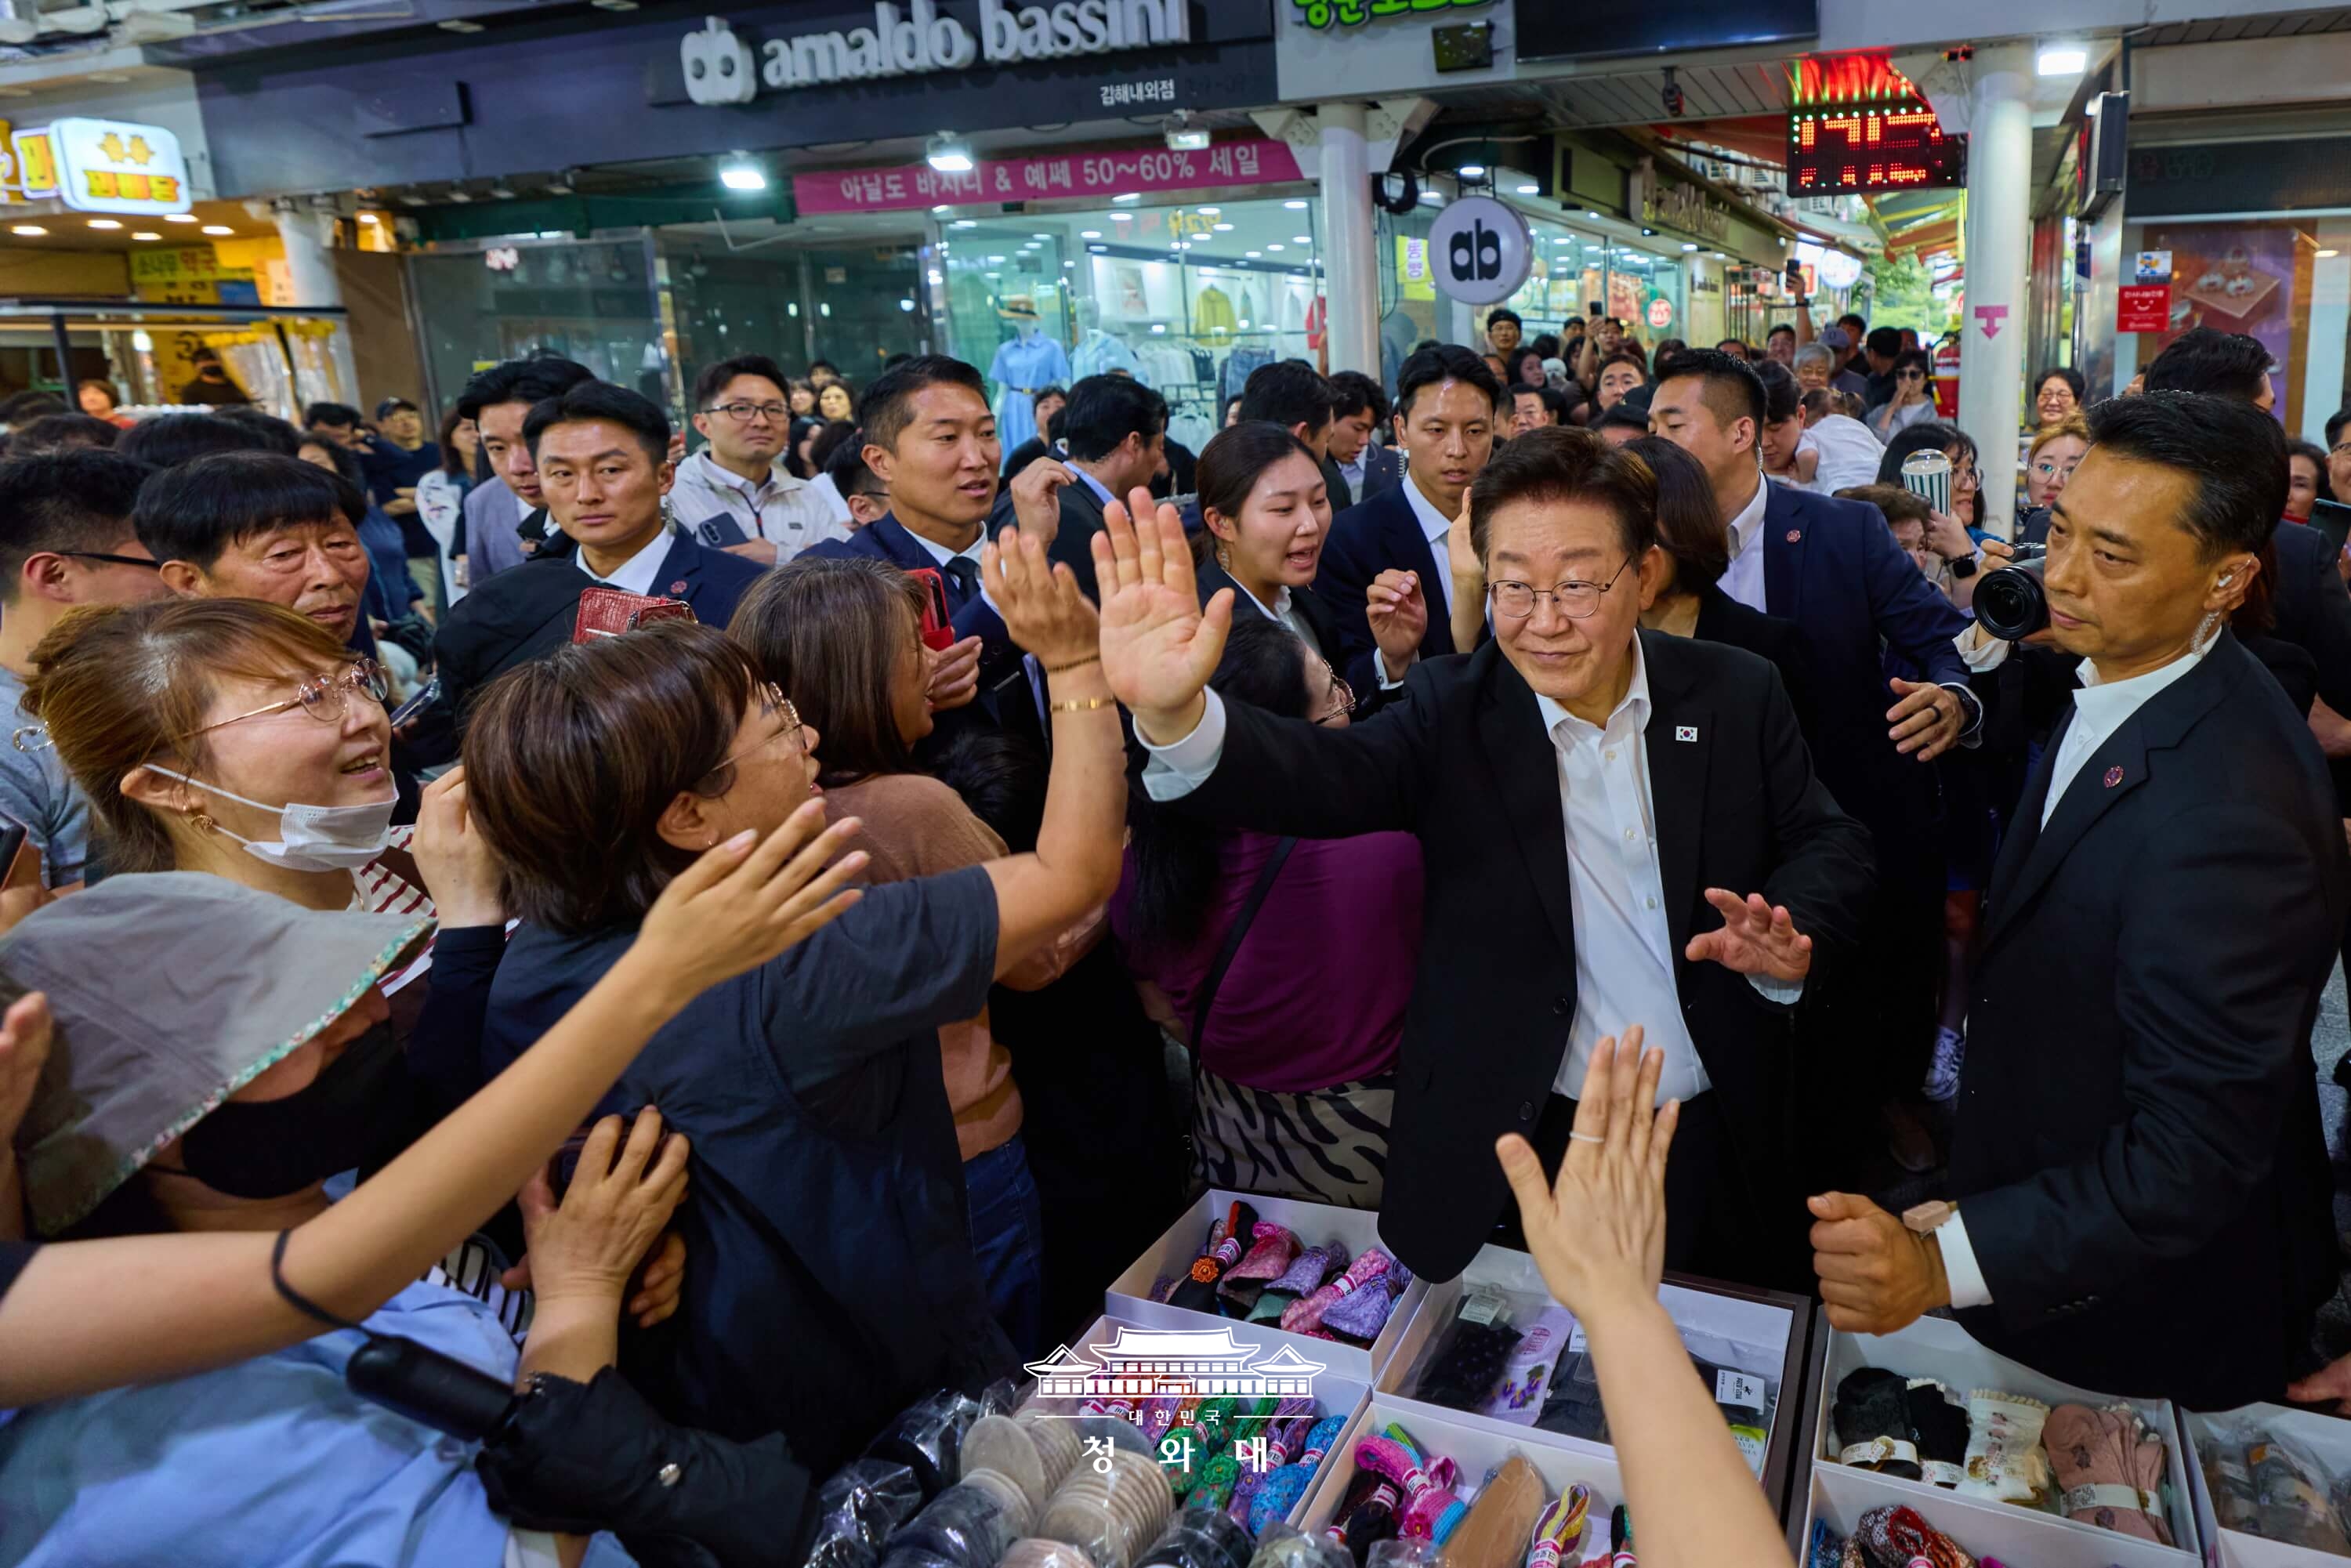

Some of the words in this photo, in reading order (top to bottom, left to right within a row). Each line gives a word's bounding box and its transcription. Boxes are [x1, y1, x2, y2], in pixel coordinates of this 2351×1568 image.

[980, 0, 1190, 61] bassini
[1100, 78, 1176, 106] 김해내외점
[995, 165, 1011, 192] &
[1083, 153, 1195, 185] 50~60%
[1209, 144, 1259, 177] 세일
[1450, 219, 1502, 282] ab
